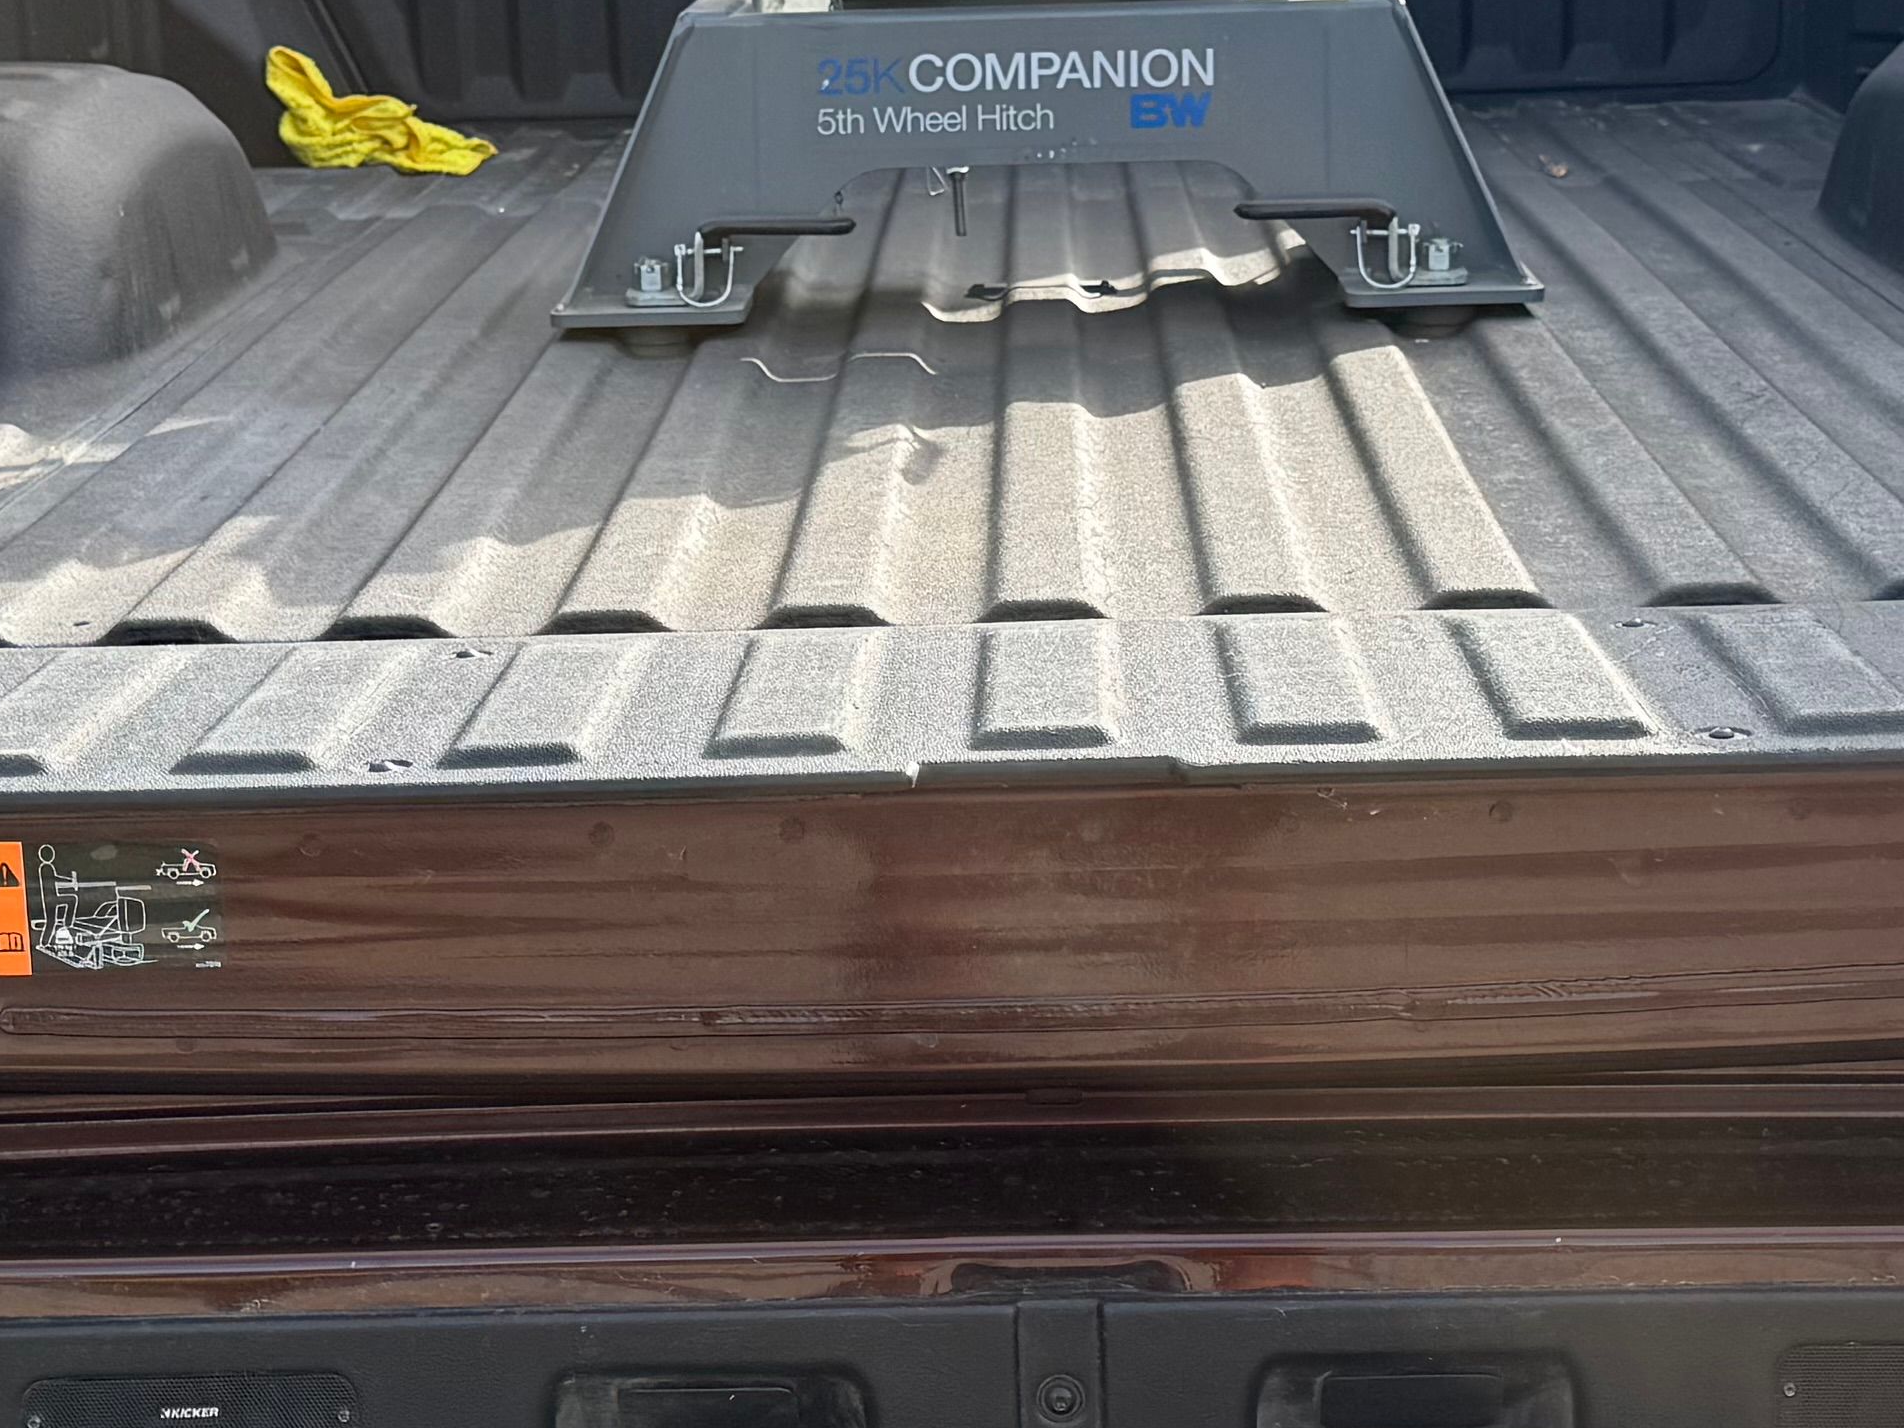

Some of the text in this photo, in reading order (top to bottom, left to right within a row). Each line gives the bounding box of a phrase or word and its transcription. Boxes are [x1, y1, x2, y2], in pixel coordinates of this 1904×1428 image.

[816, 47, 1215, 96] 25K COMPANION
[816, 103, 1055, 136] 5th Wheel Hitch
